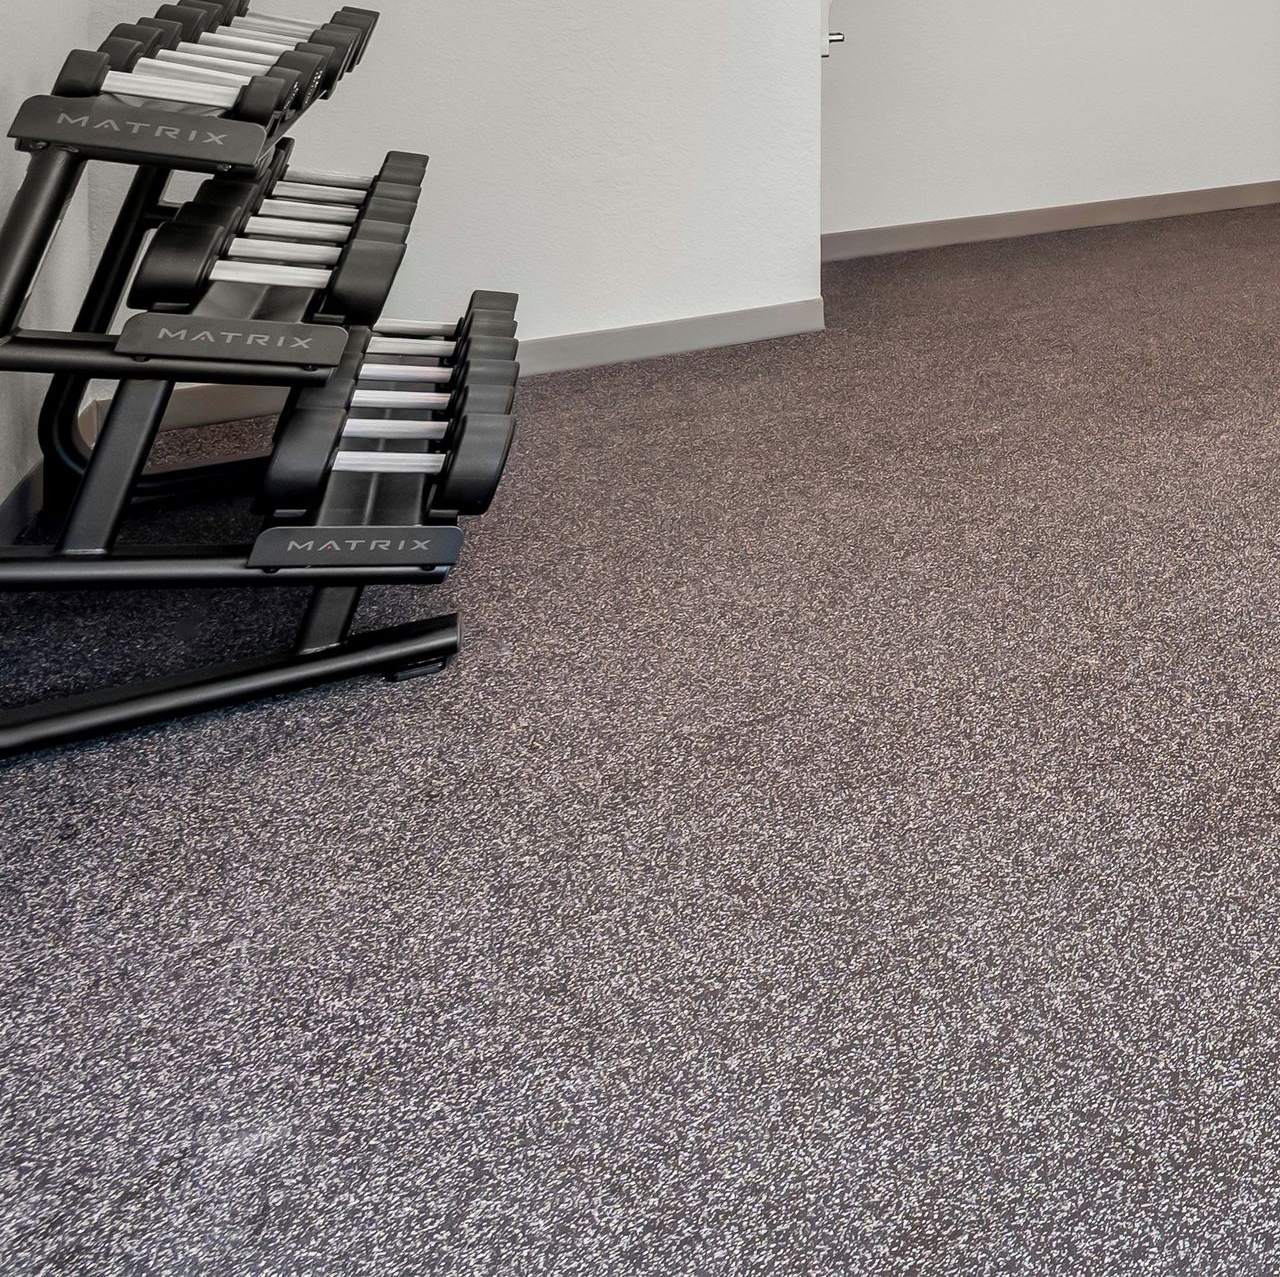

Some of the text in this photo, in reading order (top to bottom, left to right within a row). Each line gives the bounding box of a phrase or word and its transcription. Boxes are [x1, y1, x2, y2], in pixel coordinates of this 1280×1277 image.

[56, 113, 228, 146] MATRIX
[157, 327, 313, 349] MATRIX
[287, 539, 432, 551] MATRIX
